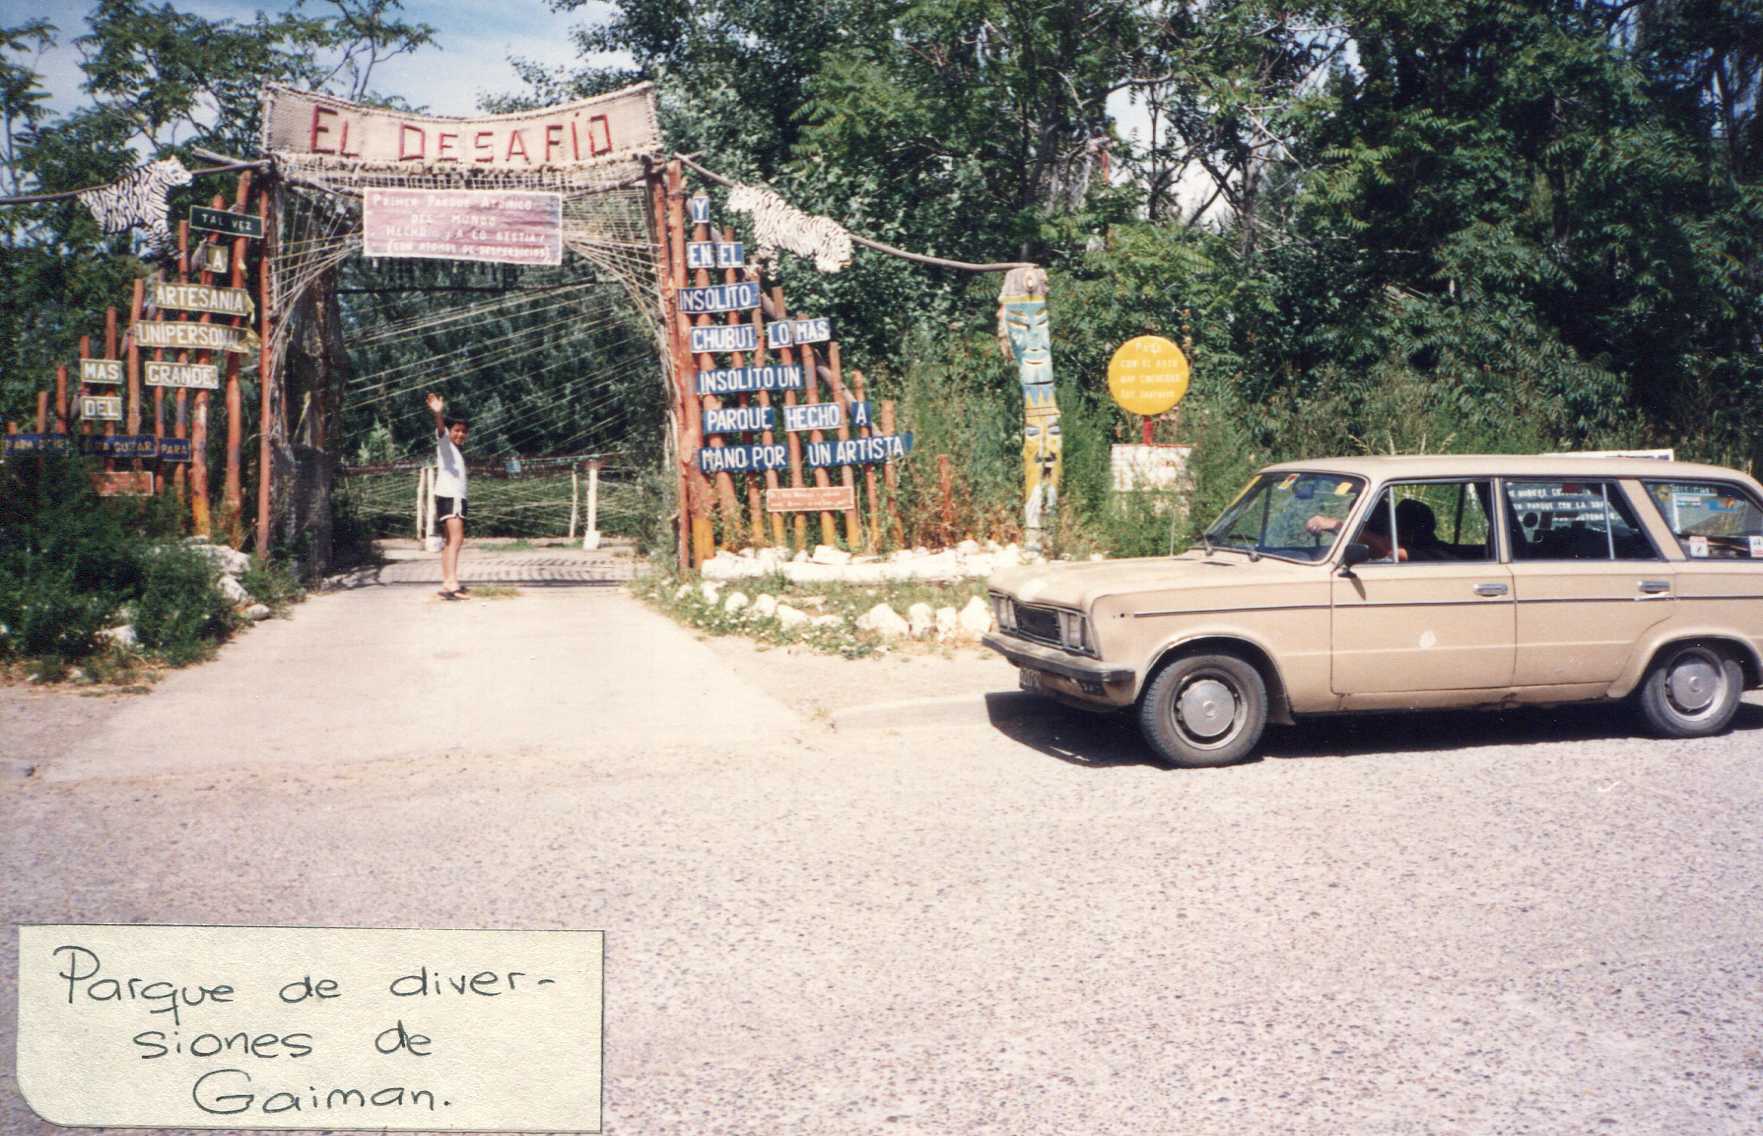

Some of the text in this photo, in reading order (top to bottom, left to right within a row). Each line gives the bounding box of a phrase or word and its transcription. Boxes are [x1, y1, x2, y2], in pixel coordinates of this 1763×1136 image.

[310, 103, 613, 163] EL DESAFÍO
[694, 200, 705, 221] Y
[201, 213, 252, 232] TAL VEZ
[212, 249, 224, 269] A
[691, 245, 739, 266] EN EL
[156, 286, 244, 312] ARTESANIA
[138, 322, 240, 348] UNIPERSONAL
[692, 320, 830, 350] CHUBUT LO MAS
[84, 363, 120, 381] MAS
[147, 365, 212, 385] GRANDE
[777, 366, 801, 388] UN
[84, 400, 118, 417] DEL
[708, 405, 866, 430] PARQUE HECHO A
[701, 436, 904, 470] MANO POR UN ARTISTA
